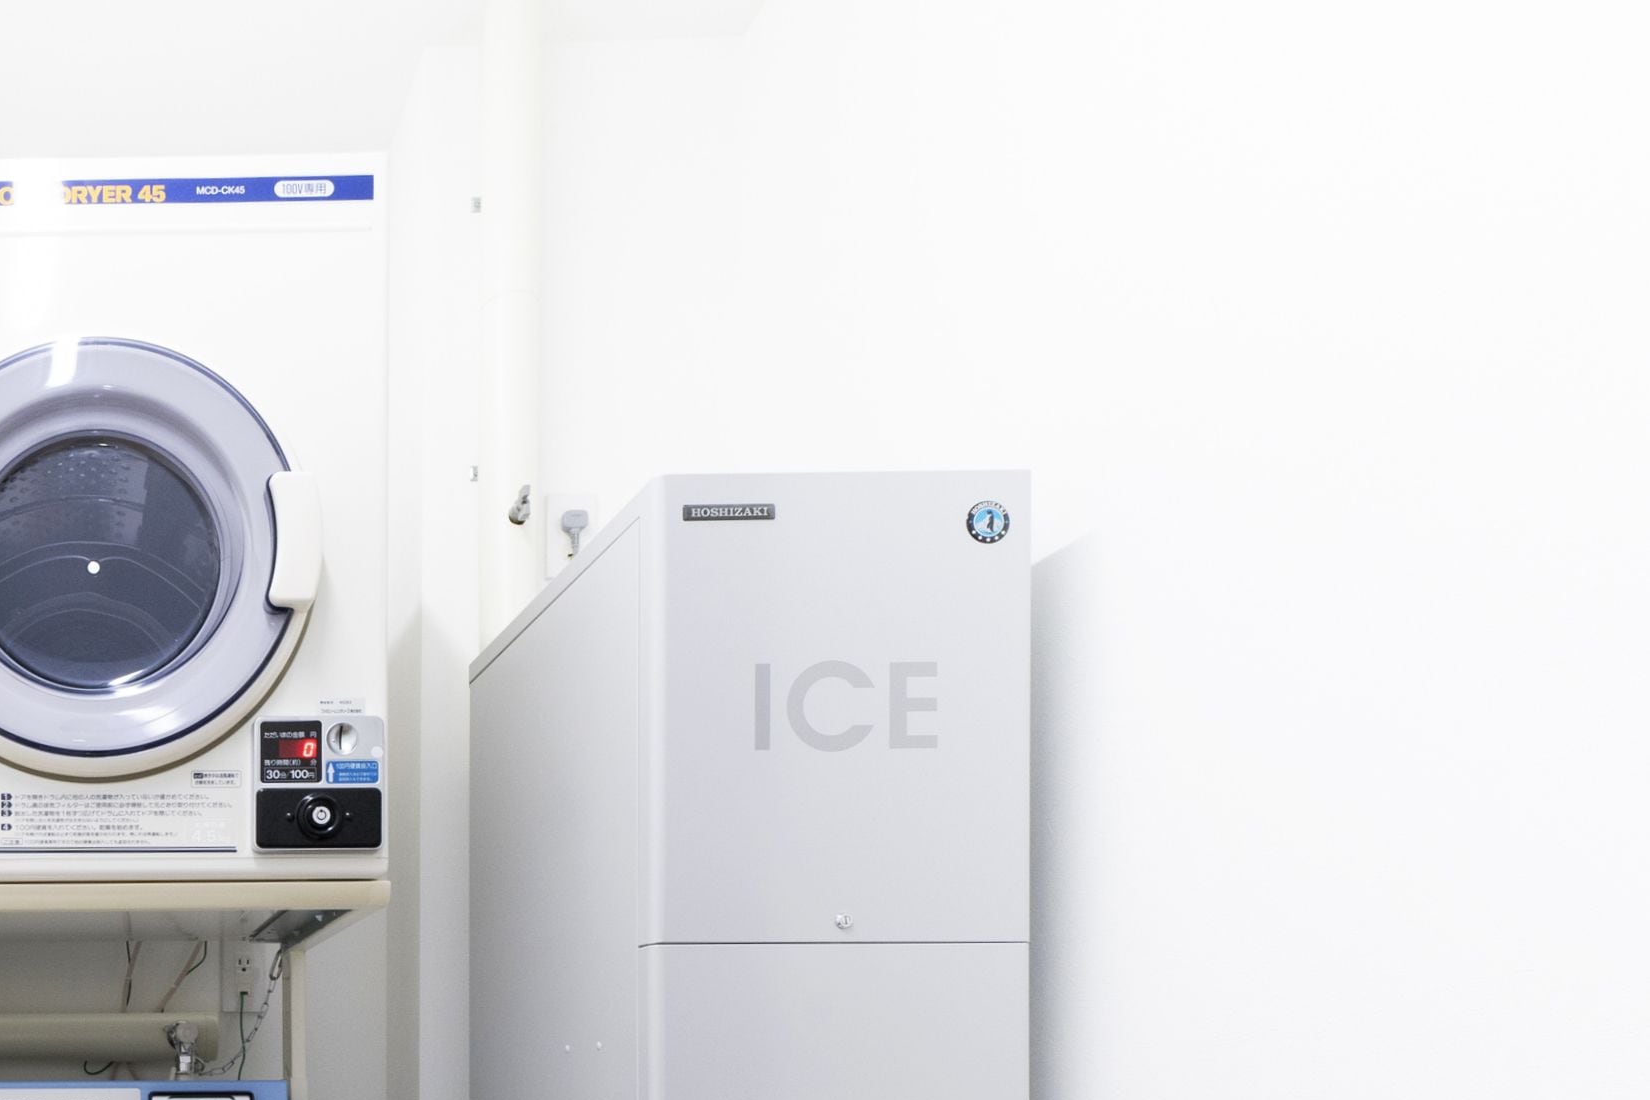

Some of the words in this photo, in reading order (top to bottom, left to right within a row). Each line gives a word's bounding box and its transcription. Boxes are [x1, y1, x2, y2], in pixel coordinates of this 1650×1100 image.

[137, 185, 167, 203] 45
[196, 186, 246, 195] MCD-CK45
[691, 507, 768, 518] HOSHIZAKI
[754, 660, 938, 752] ICE
[303, 742, 314, 757] 0
